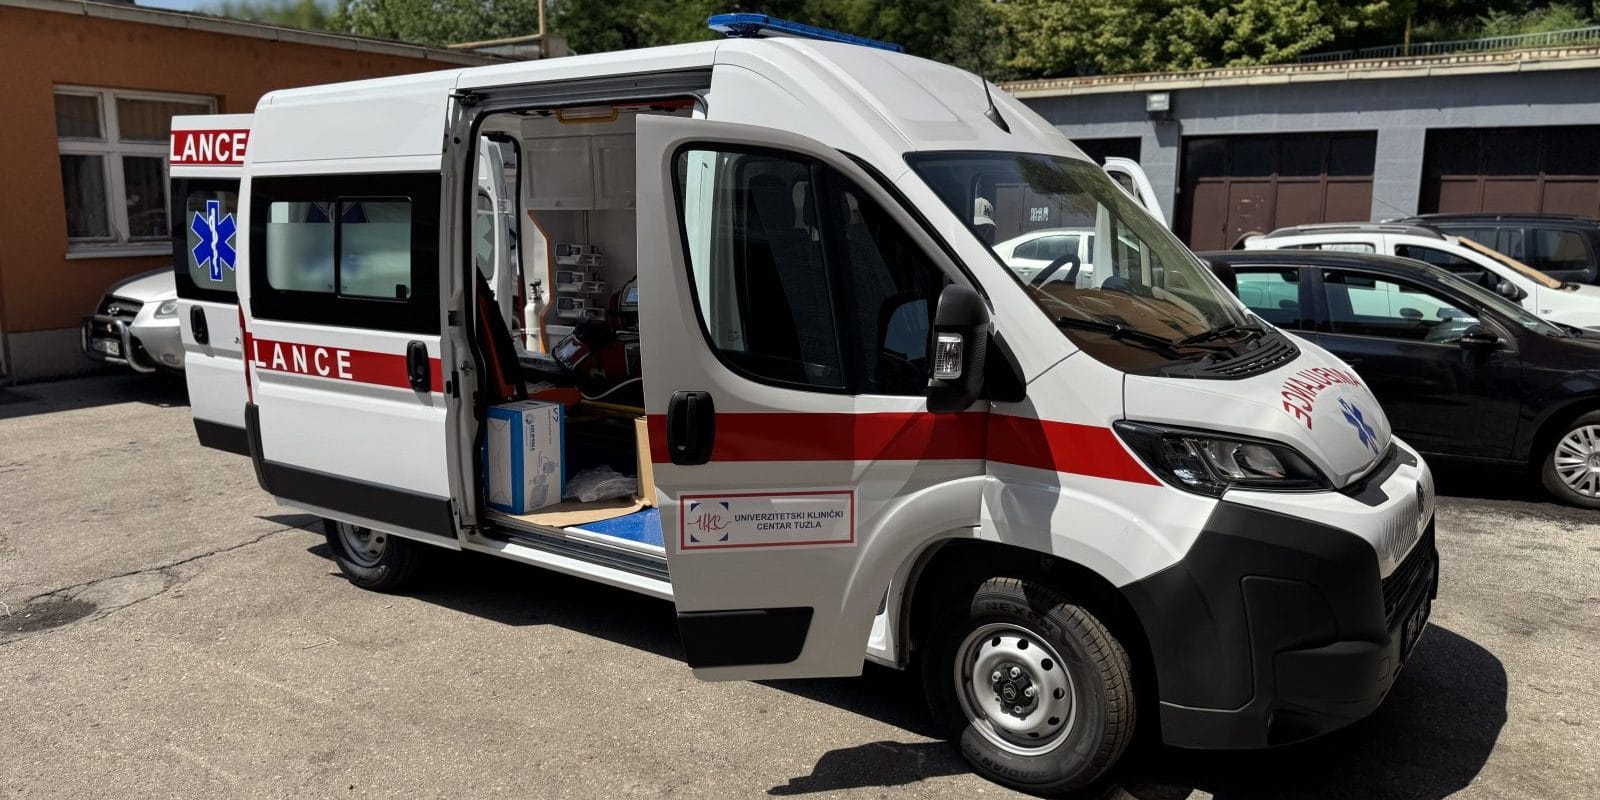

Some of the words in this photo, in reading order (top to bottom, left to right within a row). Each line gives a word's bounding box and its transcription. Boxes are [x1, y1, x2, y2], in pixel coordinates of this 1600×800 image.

[170, 132, 247, 162] LANCE
[253, 340, 353, 379] LANCE
[735, 511, 805, 522] UNIVERZITETSKI
[807, 510, 844, 519] KLINIČKI
[757, 522, 792, 531] CENTAR
[794, 520, 822, 529] TUZLA
